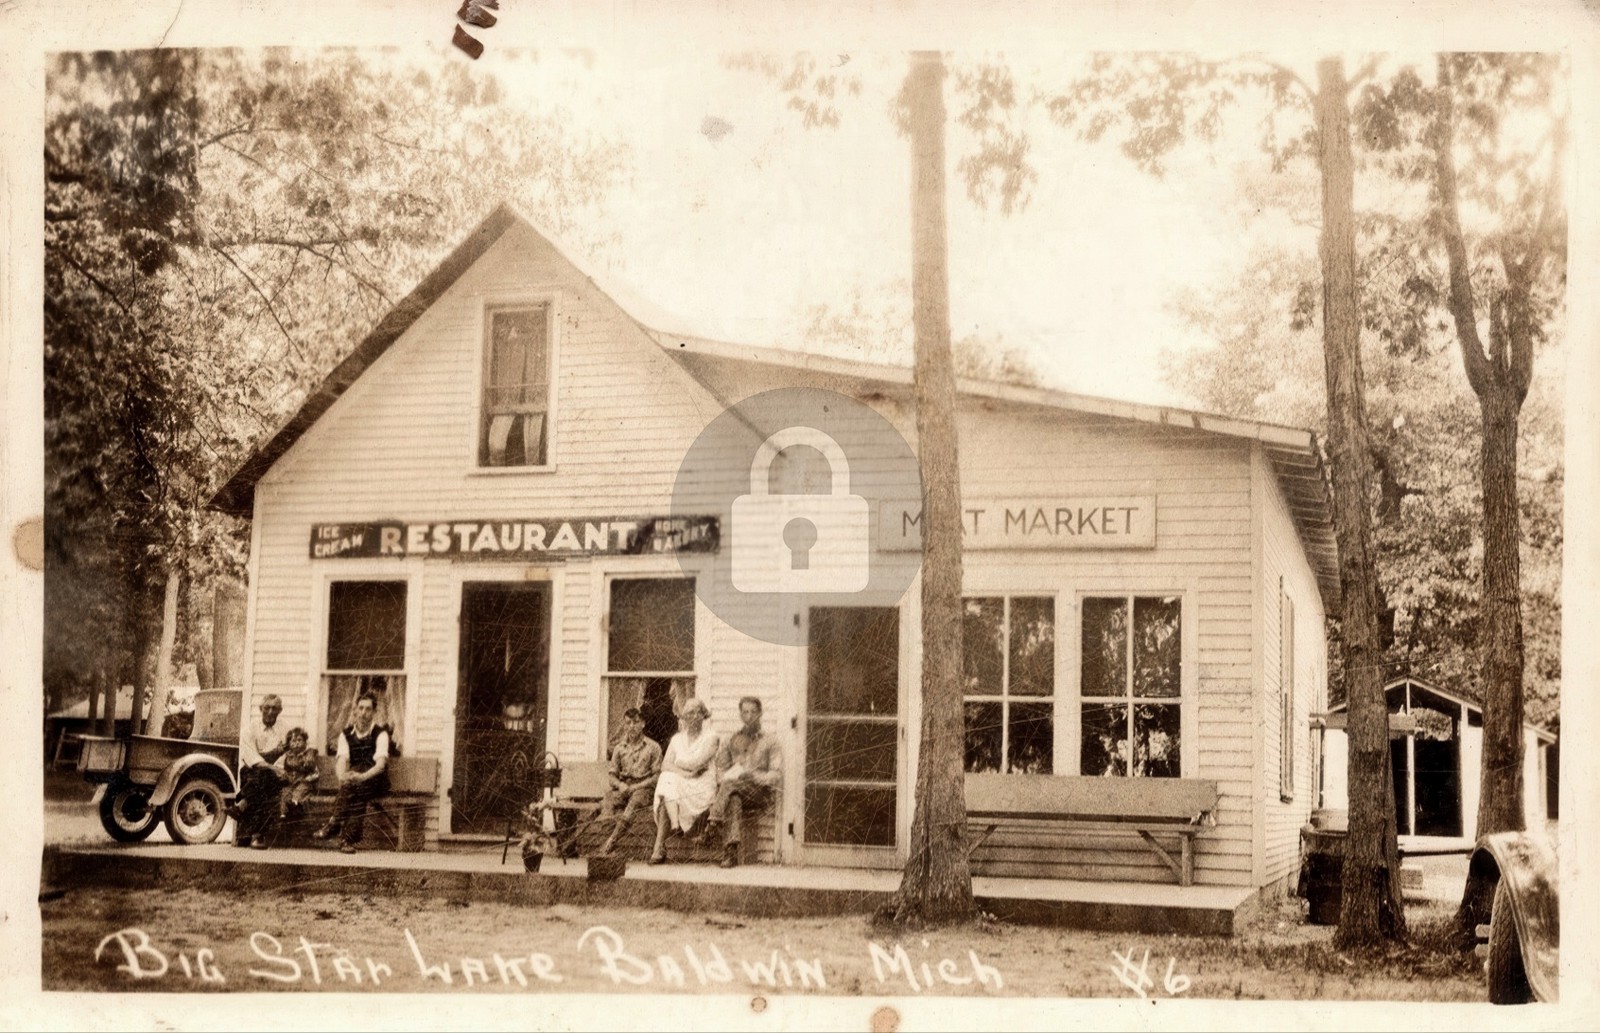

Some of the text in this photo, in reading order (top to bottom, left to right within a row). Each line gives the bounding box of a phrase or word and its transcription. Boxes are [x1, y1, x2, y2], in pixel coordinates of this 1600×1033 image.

[318, 526, 340, 539] ICE
[902, 506, 1139, 537] MT MARKET
[314, 533, 363, 557] CREAM
[380, 522, 638, 554] RESTAURANT
